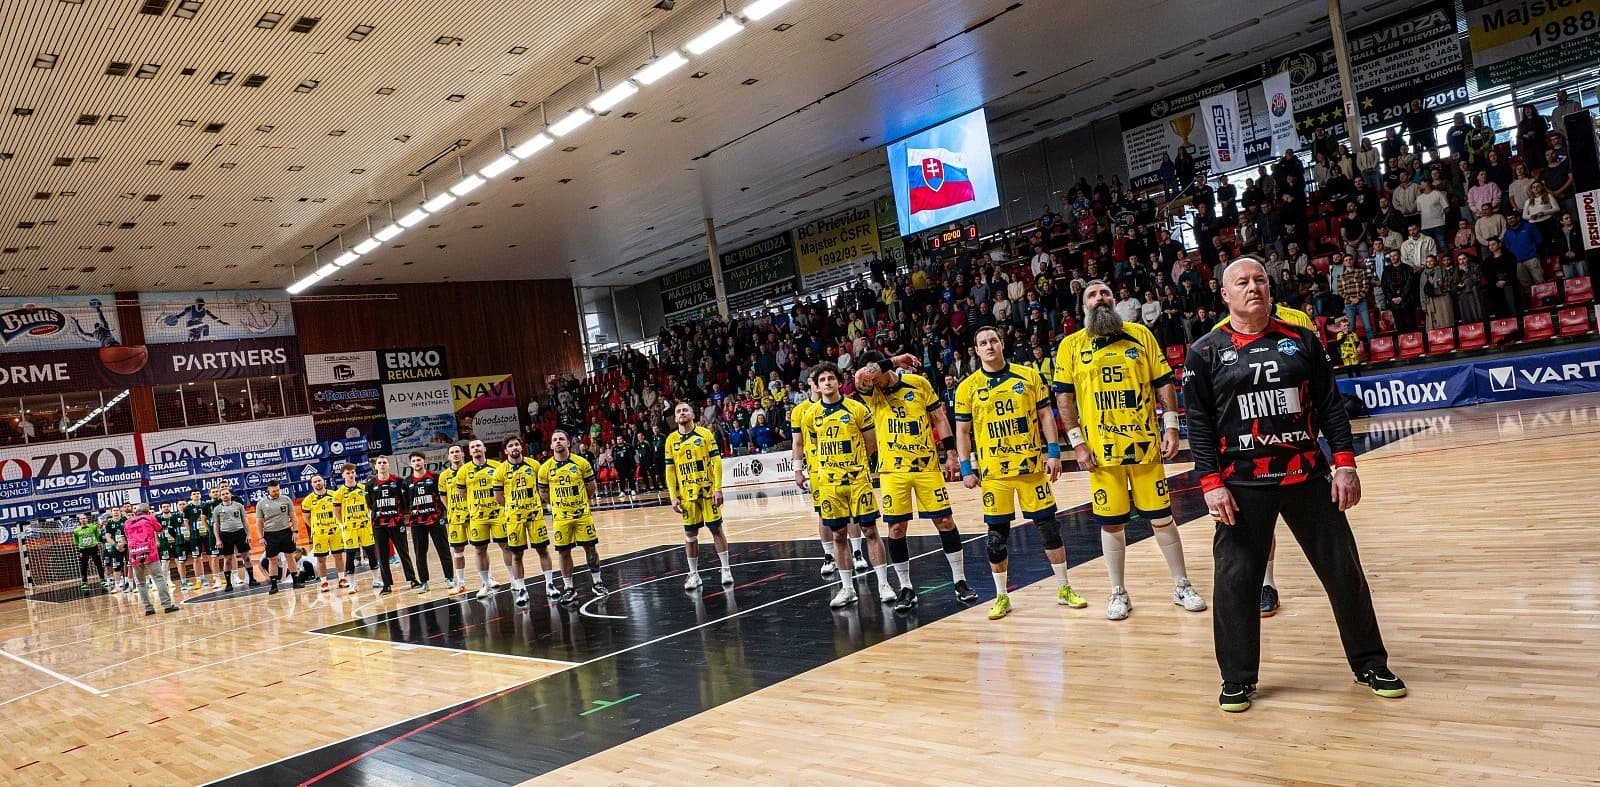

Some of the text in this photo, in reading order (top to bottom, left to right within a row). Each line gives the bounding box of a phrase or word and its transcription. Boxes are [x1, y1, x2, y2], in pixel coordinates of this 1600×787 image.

[1482, 0, 1583, 32] Majste
[1322, 8, 1450, 64] PIEVIDZA
[1360, 112, 1380, 127] SR
[1383, 87, 1467, 121] 201/2016
[1213, 106, 1228, 148] TIPOS
[797, 208, 870, 240] BC Prievidza
[800, 223, 872, 256] Majster ČSFR
[970, 227, 976, 238] 0
[724, 235, 787, 266] BC PRIEVIDZA
[817, 245, 857, 267] 1992/93
[172, 347, 287, 373] PARTNERS
[385, 350, 440, 369] ERKO
[387, 367, 442, 381] REKLAMA
[1102, 365, 1123, 384] 85
[1249, 360, 1281, 385] 72
[1520, 360, 1600, 385] VART
[454, 380, 514, 400] NAVI
[1355, 380, 1447, 409] JobRoxx
[411, 399, 450, 408] INVESTMENTS
[994, 398, 1015, 417] 84
[1094, 390, 1118, 411] BENY
[1237, 389, 1276, 421] BENY
[891, 406, 906, 418] 56
[475, 414, 518, 427] Woodstock
[1105, 423, 1142, 433] VARTA
[826, 426, 839, 438] 47
[987, 418, 1012, 439] BENY
[267, 441, 279, 449] na
[281, 436, 313, 448] dôvere
[1257, 430, 1310, 446] VARTA
[160, 445, 210, 463] DAK
[686, 449, 693, 460] 8
[820, 441, 838, 456] BENY
[897, 443, 929, 451] VARTA
[1000, 443, 1036, 454] VARTA
[148, 460, 188, 472] STRABAG
[733, 462, 750, 478] niké
[828, 460, 857, 468] VARTA
[0, 480, 28, 490] ESTO
[36, 474, 87, 491] JKBOZ
[479, 478, 487, 487] 19
[516, 479, 526, 487] 23
[558, 475, 571, 485] 24
[160, 485, 193, 496] VARTA
[934, 487, 949, 502] 56
[1035, 482, 1051, 501] 84
[37, 496, 92, 511] top cafe
[97, 490, 123, 509] BENY
[861, 492, 873, 506] 47
[712, 504, 718, 515] 8
[537, 527, 548, 537] 23
[586, 525, 596, 535] 24
